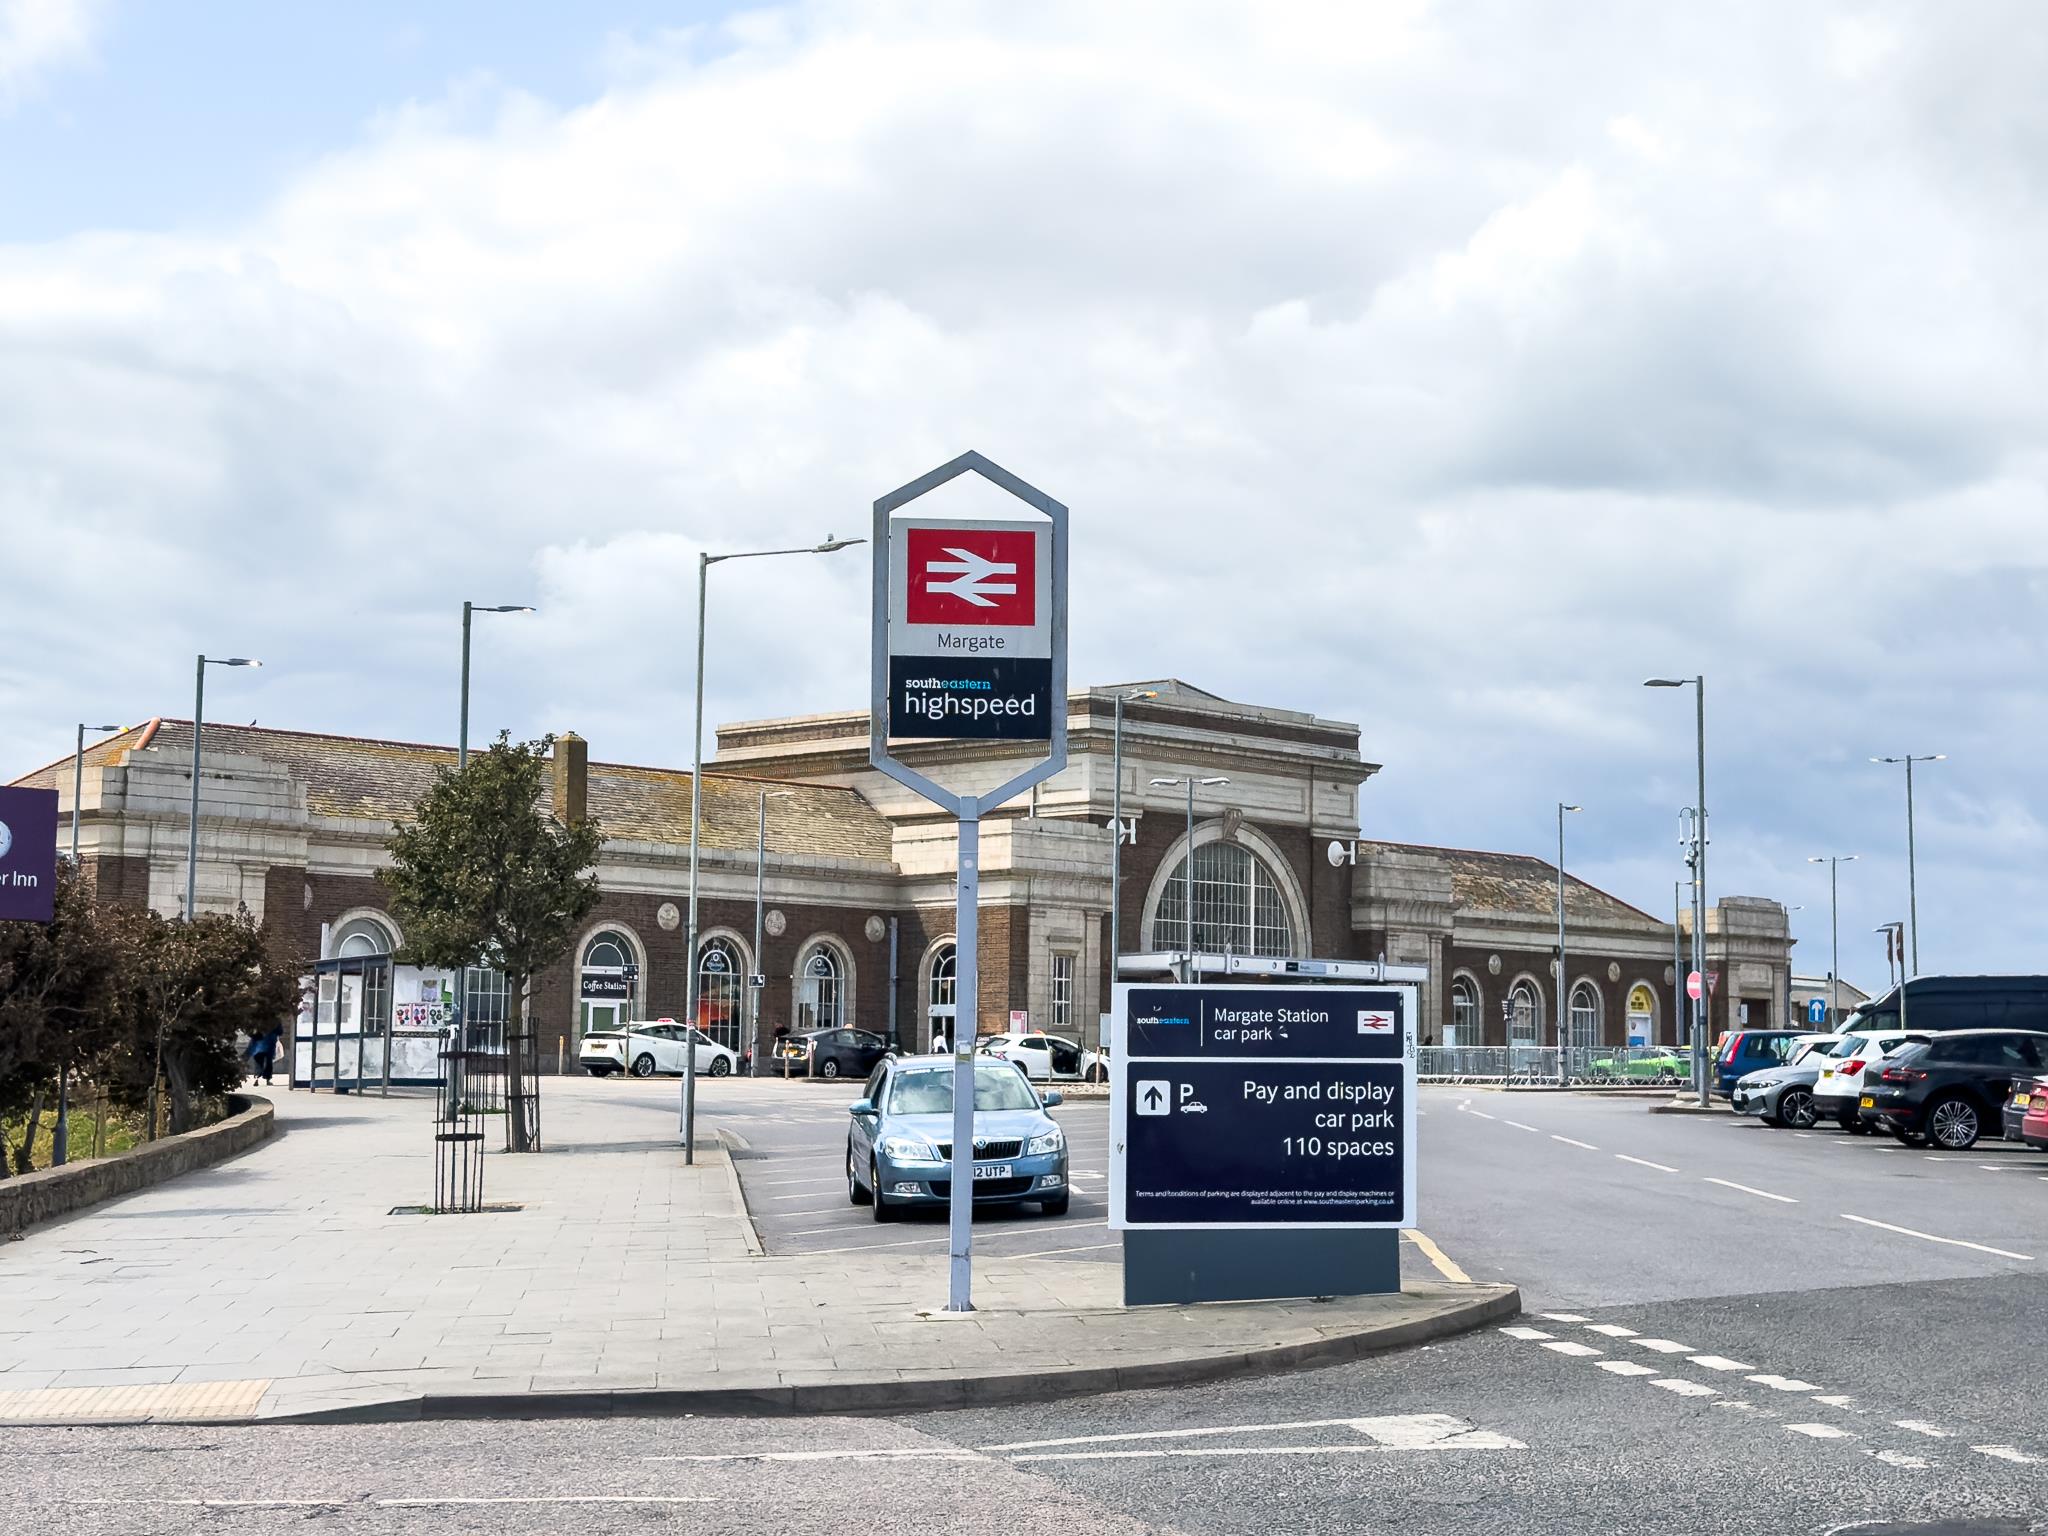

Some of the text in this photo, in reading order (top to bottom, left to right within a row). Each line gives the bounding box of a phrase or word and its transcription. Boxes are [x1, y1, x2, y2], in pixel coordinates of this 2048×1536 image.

[938, 633, 1005, 652] Margate
[905, 677, 991, 690] southeastern
[905, 691, 1035, 720] highspeed
[13, 870, 38, 888] Inn
[583, 980, 627, 992] Coffee Station
[1136, 1016, 1190, 1025] southeastern
[1215, 1008, 1328, 1025] Margate Station
[1215, 1026, 1272, 1042] car park
[1180, 1084, 1193, 1102] P
[1244, 1081, 1394, 1104] Pay and display
[1315, 1110, 1394, 1131] car park
[1284, 1138, 1394, 1159] 110 spaces
[985, 1166, 1006, 1178] UTP
[1136, 1190, 1154, 1198] Terms
[1156, 1190, 1166, 1198] and
[1200, 1190, 1207, 1198] of
[1208, 1190, 1229, 1199] parking
[1231, 1190, 1239, 1198] are
[1241, 1190, 1268, 1199] displayed
[1269, 1190, 1294, 1198] adjacent
[1296, 1190, 1302, 1198] to
[1303, 1190, 1312, 1198] the
[1314, 1190, 1324, 1199] pay
[1326, 1190, 1336, 1198] and
[1338, 1190, 1358, 1199] display
[1359, 1190, 1387, 1198] machines
[1388, 1190, 1394, 1198] or
[1251, 1198, 1275, 1206] available
[1277, 1198, 1295, 1206] online
[1297, 1198, 1302, 1206] at
